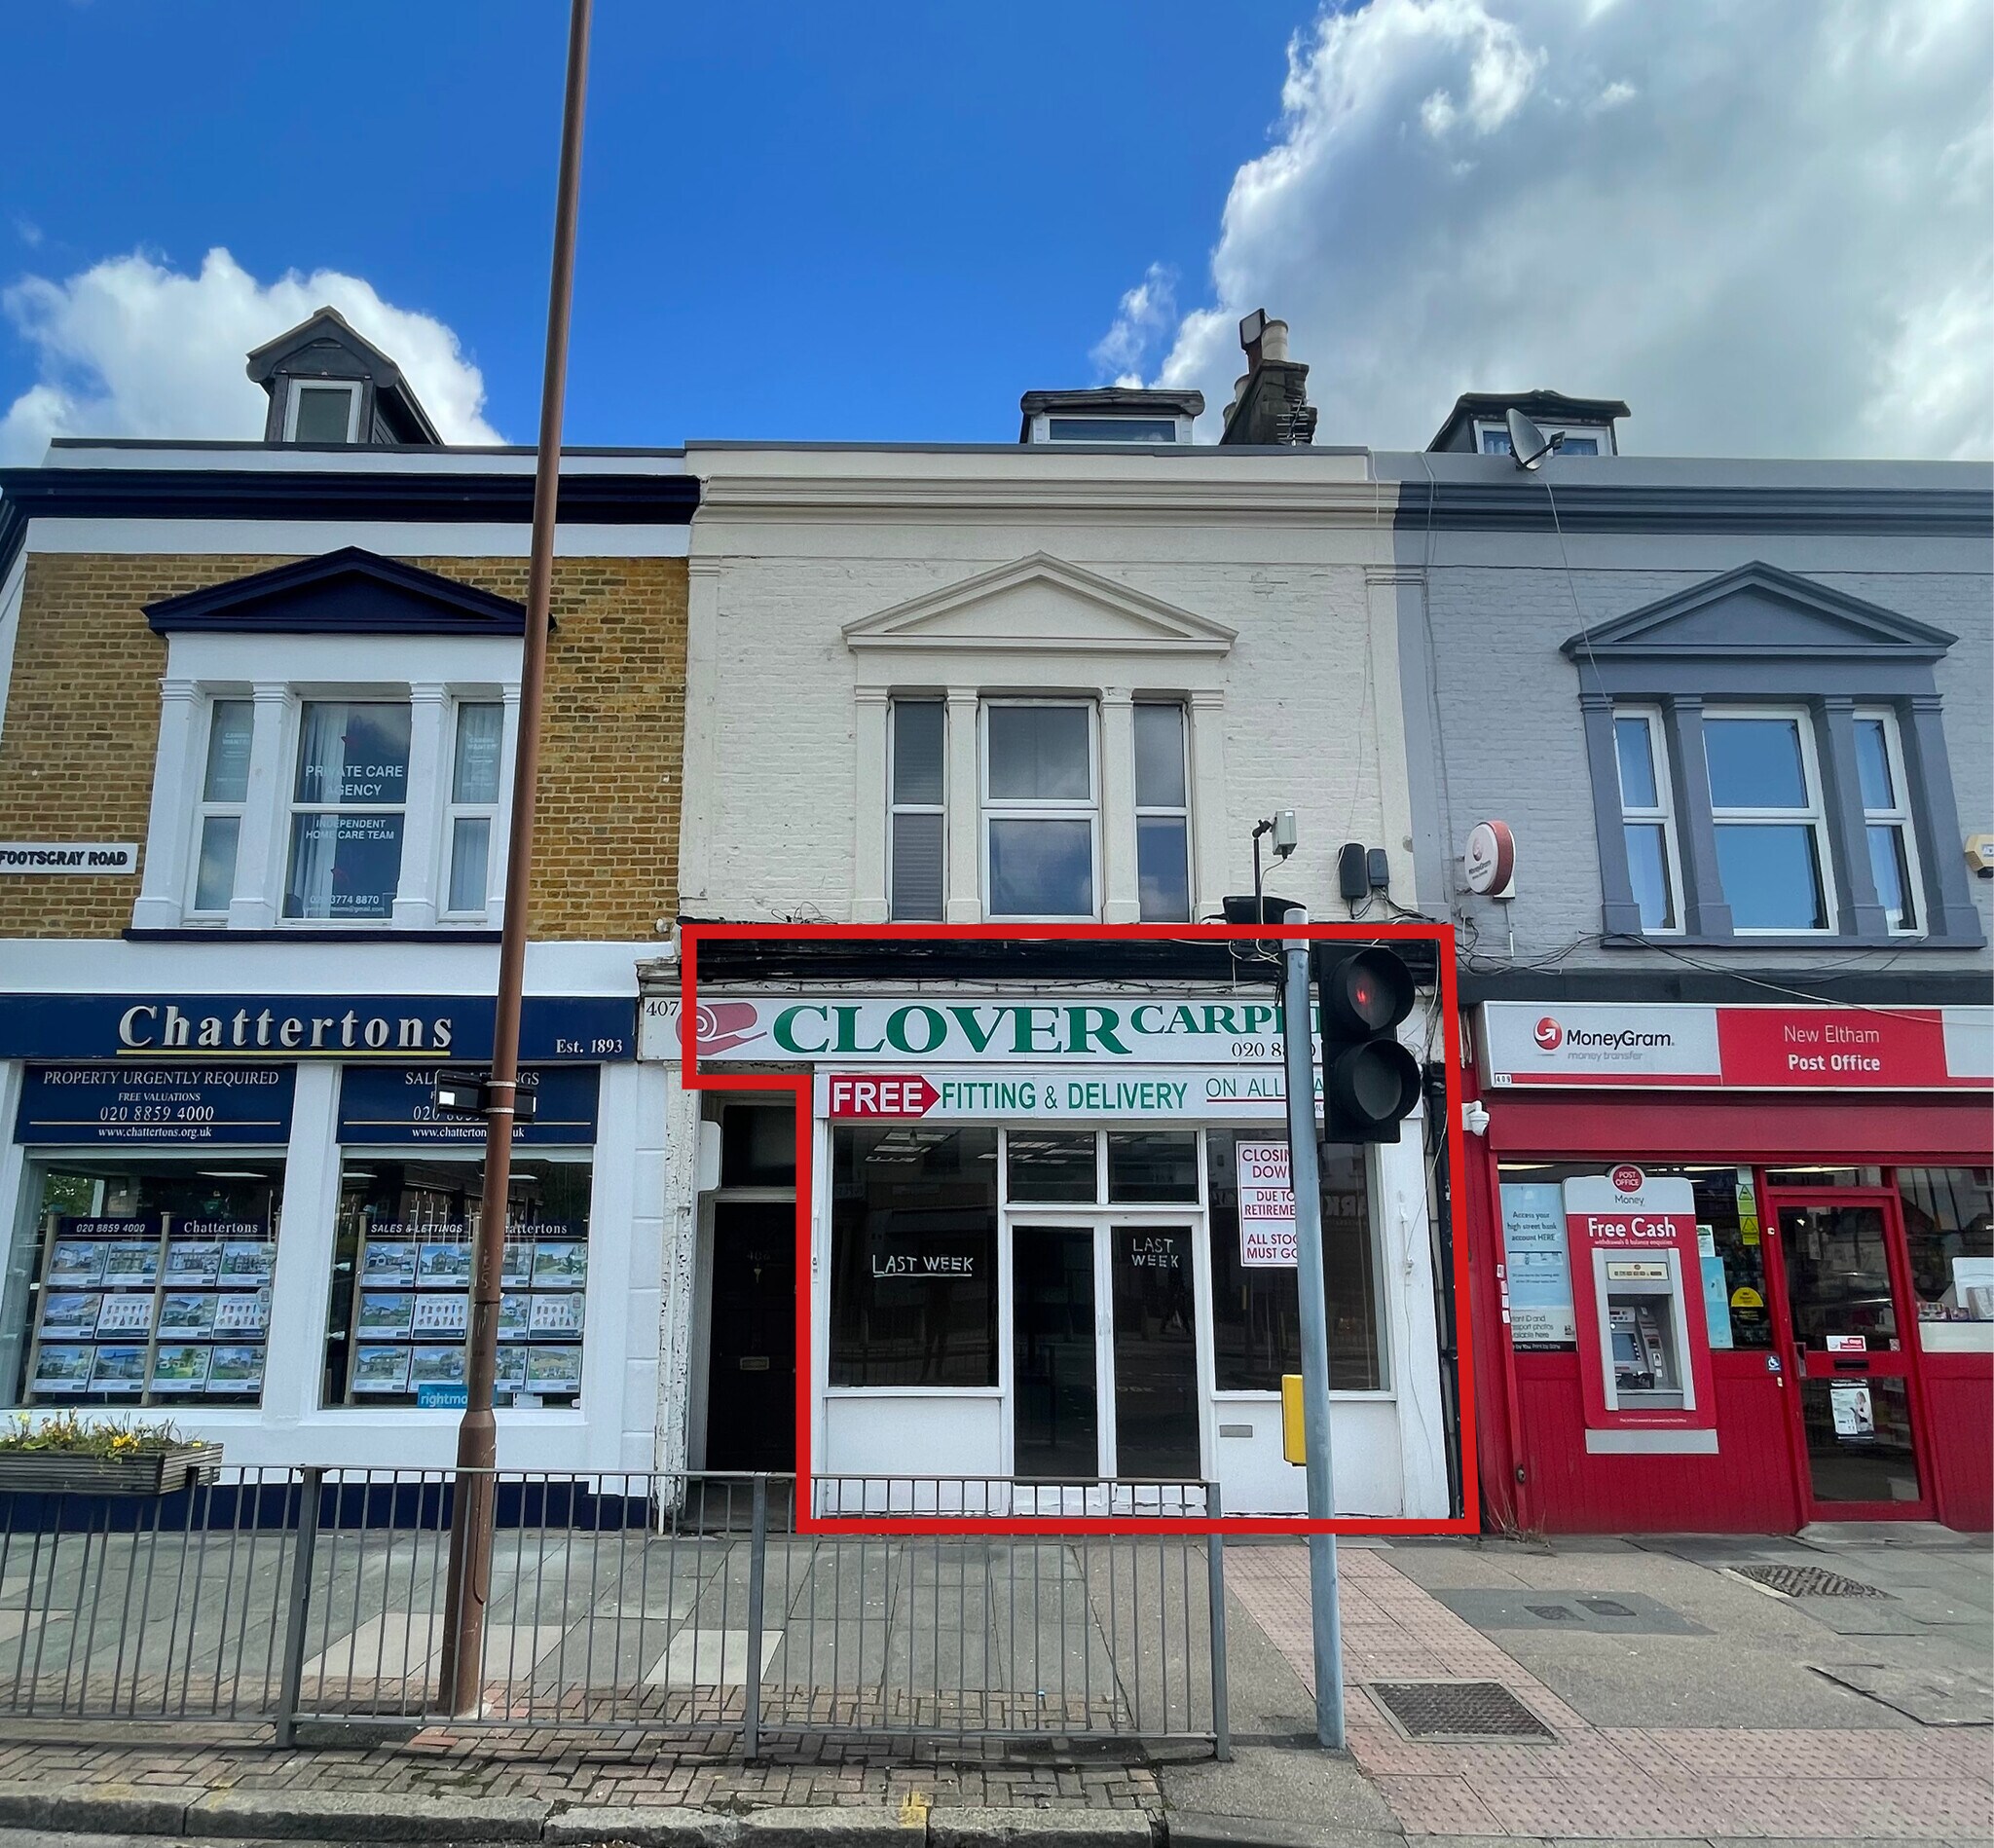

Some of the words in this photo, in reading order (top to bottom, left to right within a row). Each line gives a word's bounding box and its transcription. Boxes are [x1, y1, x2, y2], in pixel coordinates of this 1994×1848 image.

[305, 764, 362, 778] PRATE
[365, 764, 403, 778] CARE
[315, 819, 387, 829] INDEPENDENT
[337, 830, 365, 839] CARE
[366, 831, 395, 840] TEAM
[0, 850, 85, 866] FOOTSCRAY
[88, 851, 128, 866] ROAD
[330, 895, 352, 905] 3774
[354, 895, 380, 905] 8870
[646, 1000, 680, 1016] 407
[118, 1005, 453, 1048] Chattertons
[772, 1004, 1132, 1055] CLOVER
[1129, 1004, 1321, 1034] CARP
[1567, 1029, 1672, 1051] MoneyGram
[1784, 1025, 1820, 1043] New
[1825, 1025, 1880, 1044] Eltham
[556, 1039, 584, 1053] Est.
[590, 1039, 623, 1053] 1893
[1231, 1042, 1265, 1057] 020
[1567, 1052, 1602, 1062] money
[1603, 1051, 1643, 1061] transfer
[1788, 1053, 1827, 1071] Post
[1830, 1054, 1881, 1071] Office
[43, 1070, 122, 1085] PROPERTY
[123, 1071, 202, 1086] URGENTLY
[203, 1071, 279, 1087] REQUIRED
[405, 1072, 437, 1086] SAL
[118, 1092, 141, 1102] FREE
[143, 1092, 202, 1102] VALUATIONS
[833, 1082, 924, 1113] FREE
[941, 1081, 1036, 1110] FITTING
[1045, 1085, 1058, 1110] &
[1068, 1082, 1188, 1110] DELIVERY
[1205, 1077, 1237, 1098] ON
[1247, 1077, 1285, 1097] ALL
[99, 1106, 128, 1122] 020
[133, 1106, 171, 1122] 8859
[177, 1106, 214, 1122] 4000
[97, 1126, 212, 1140] www.chattertons.org.uk
[412, 1127, 525, 1138] www.chattertonuk
[1242, 1149, 1289, 1163] CLOSI
[1252, 1165, 1288, 1178] DOW
[1614, 1178, 1640, 1187] OFFICE
[1256, 1190, 1278, 1201] DUE
[1614, 1195, 1645, 1206] Money
[1244, 1204, 1296, 1216] RETIREME
[1535, 1212, 1550, 1221] your
[76, 1223, 94, 1233] 020
[96, 1223, 121, 1233] 8859
[123, 1223, 146, 1233] 4000
[183, 1220, 259, 1234] Chattertons
[370, 1223, 403, 1234] SALES
[415, 1223, 463, 1234] LETTINGS
[504, 1223, 568, 1235] attertons
[1588, 1217, 1626, 1238] Free
[1631, 1216, 1677, 1238] Cash
[1131, 1238, 1174, 1252] LAST
[1247, 1234, 1268, 1244] ALL
[1246, 1247, 1277, 1259] MUST
[871, 1254, 918, 1275] LAST
[923, 1256, 974, 1272] WEEK
[1129, 1254, 1179, 1268] WEEK
[421, 1392, 467, 1408] rightmo
